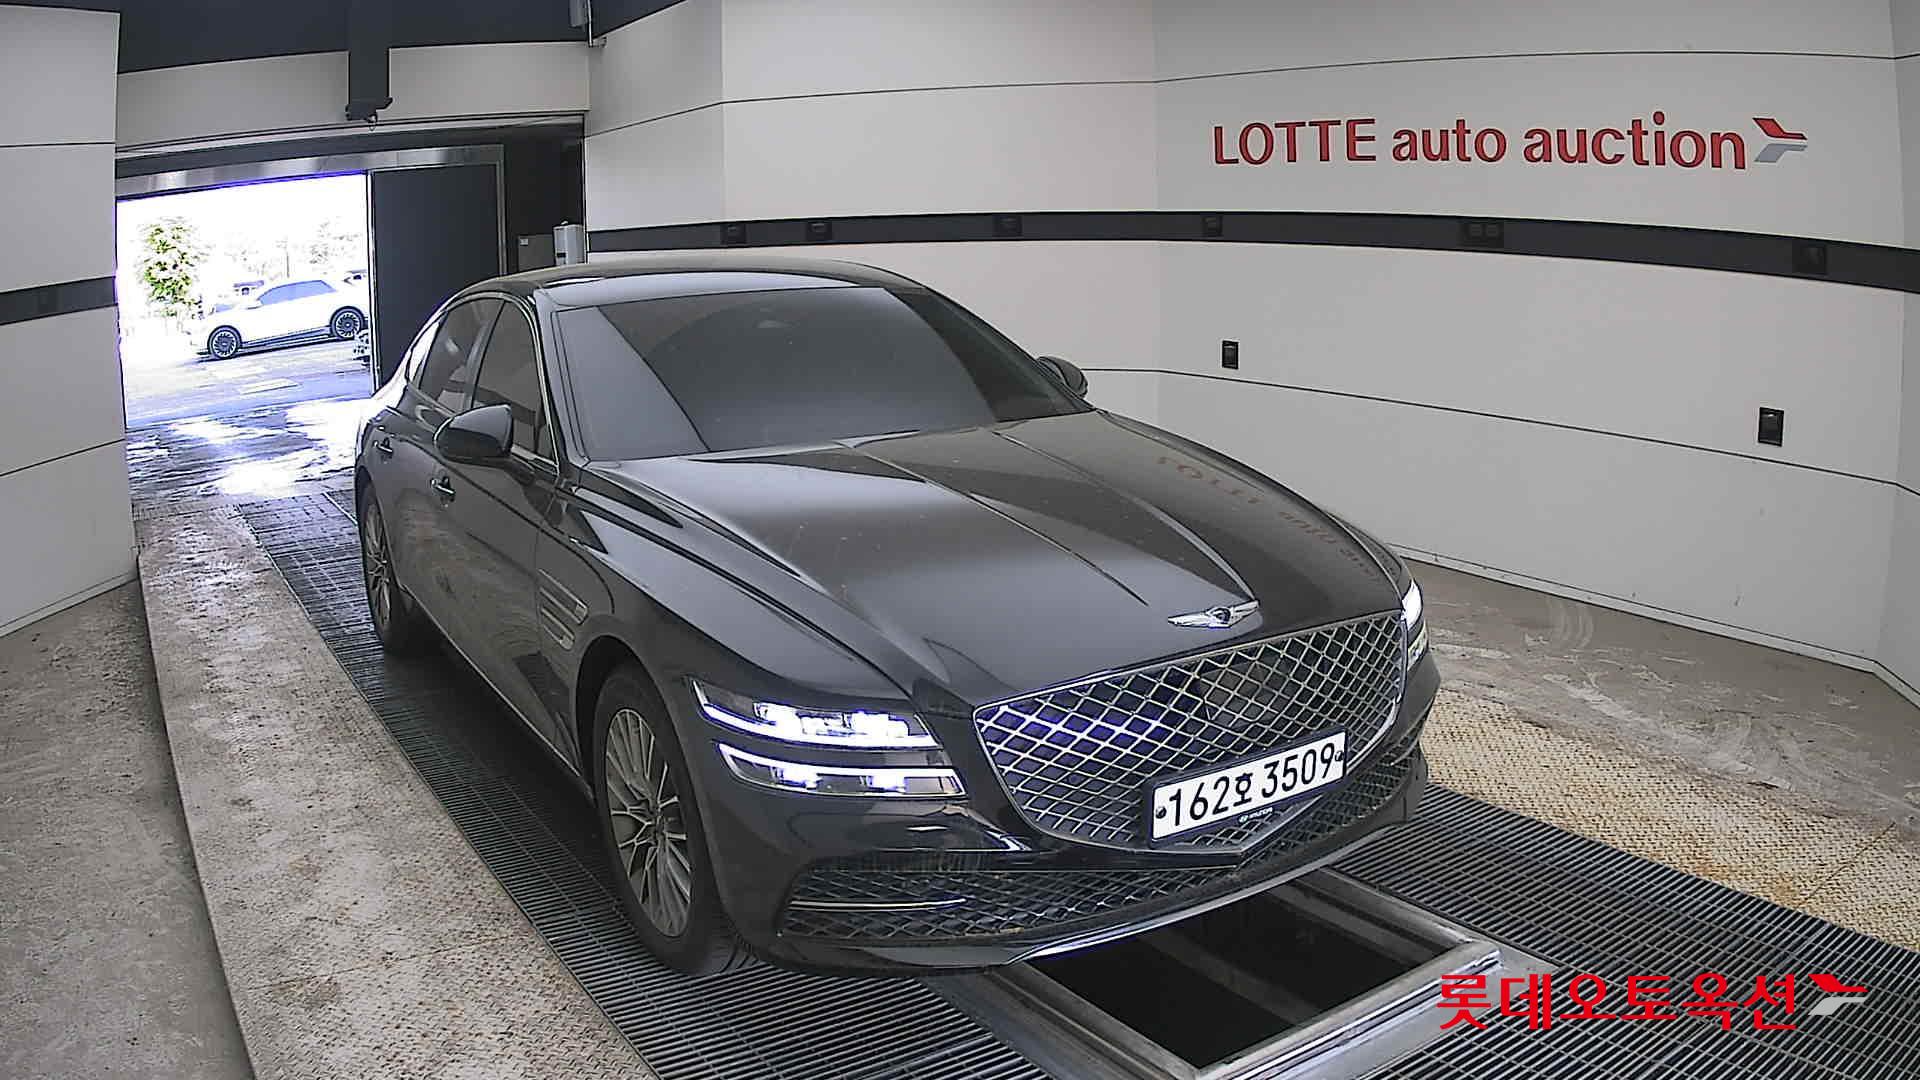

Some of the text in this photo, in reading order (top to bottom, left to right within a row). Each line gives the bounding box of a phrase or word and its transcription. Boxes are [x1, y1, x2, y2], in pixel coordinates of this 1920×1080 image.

[1213, 110, 1747, 170] LOTTE auto auction
[1168, 742, 1335, 827] 162호 3509
